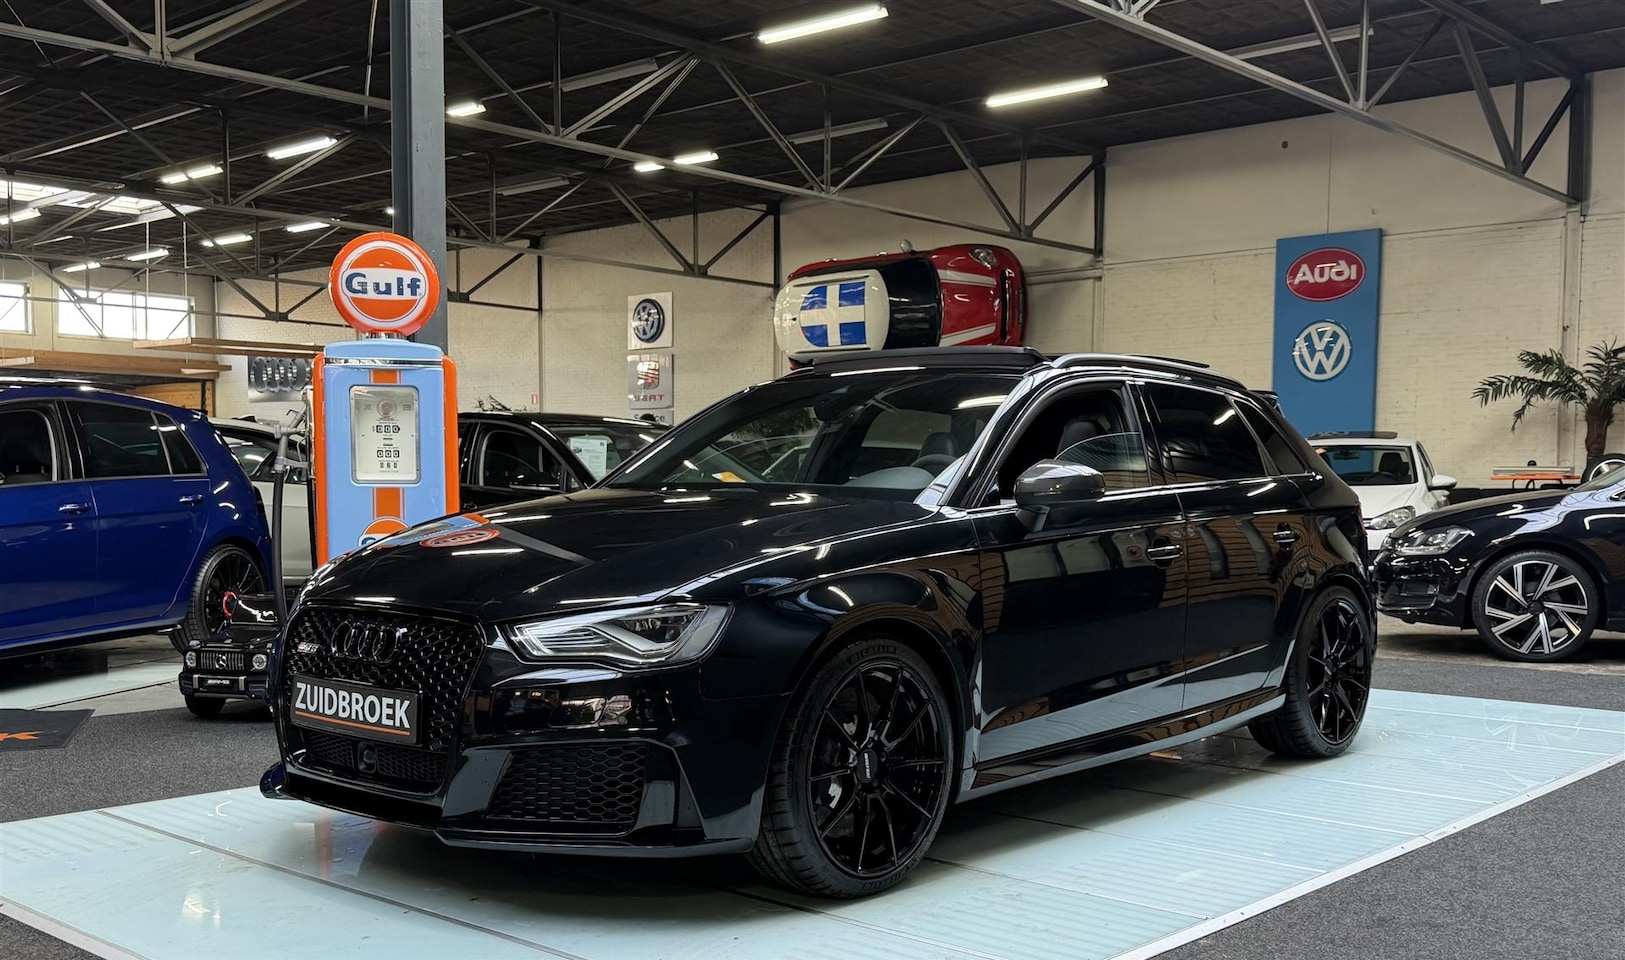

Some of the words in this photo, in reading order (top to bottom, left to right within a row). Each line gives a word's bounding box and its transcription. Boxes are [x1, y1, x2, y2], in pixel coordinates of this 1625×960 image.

[345, 272, 421, 296] Gulf
[1296, 324, 1349, 377] VW
[635, 394, 664, 402] SEAT
[295, 682, 411, 729] ZUIDBROEK
